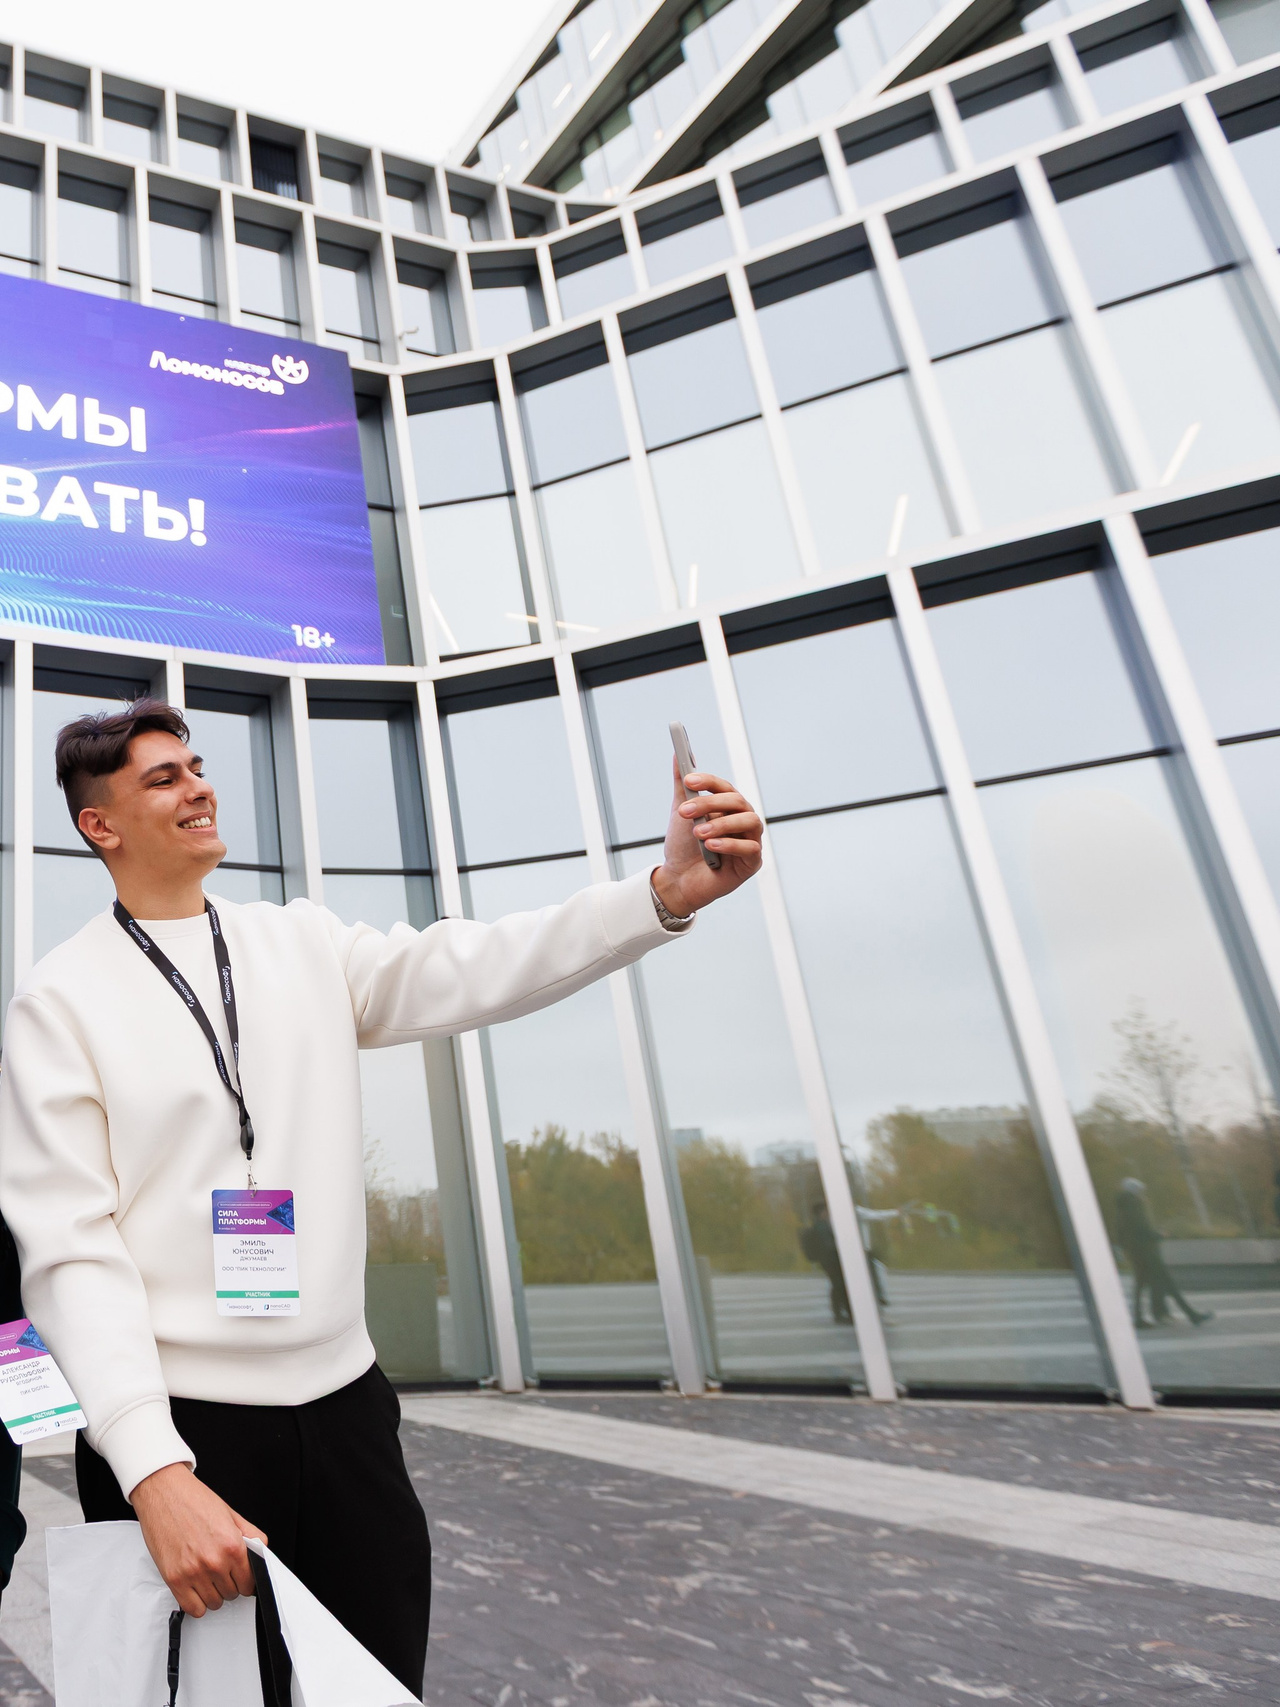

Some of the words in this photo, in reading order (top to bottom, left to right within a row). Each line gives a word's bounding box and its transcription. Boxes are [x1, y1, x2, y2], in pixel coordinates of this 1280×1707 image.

[291, 623, 336, 649] 18+
[217, 1209, 239, 1217] СИЛА
[218, 1218, 267, 1226] ПЛАТФОРМЫ
[239, 1239, 267, 1247] ЭМИЛЬ
[1, 1360, 41, 1376] АЛЕКСАНДР
